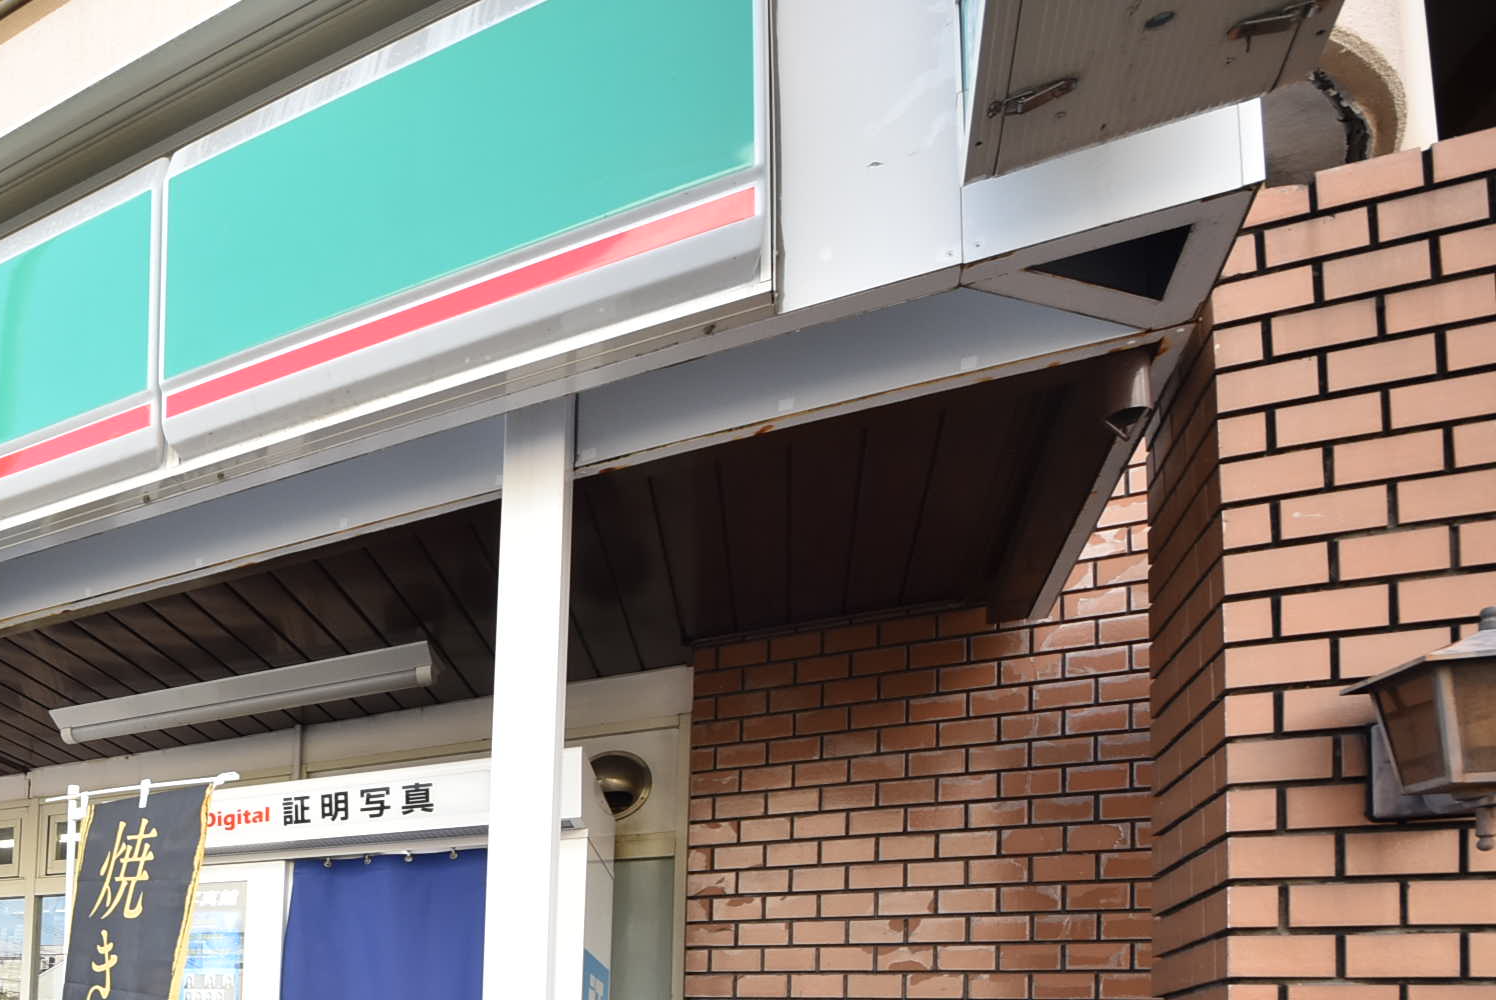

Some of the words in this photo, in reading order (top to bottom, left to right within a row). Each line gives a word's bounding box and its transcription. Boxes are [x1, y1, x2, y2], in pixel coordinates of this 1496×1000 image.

[206, 807, 272, 832] Digital
[282, 782, 435, 827] 証明写真
